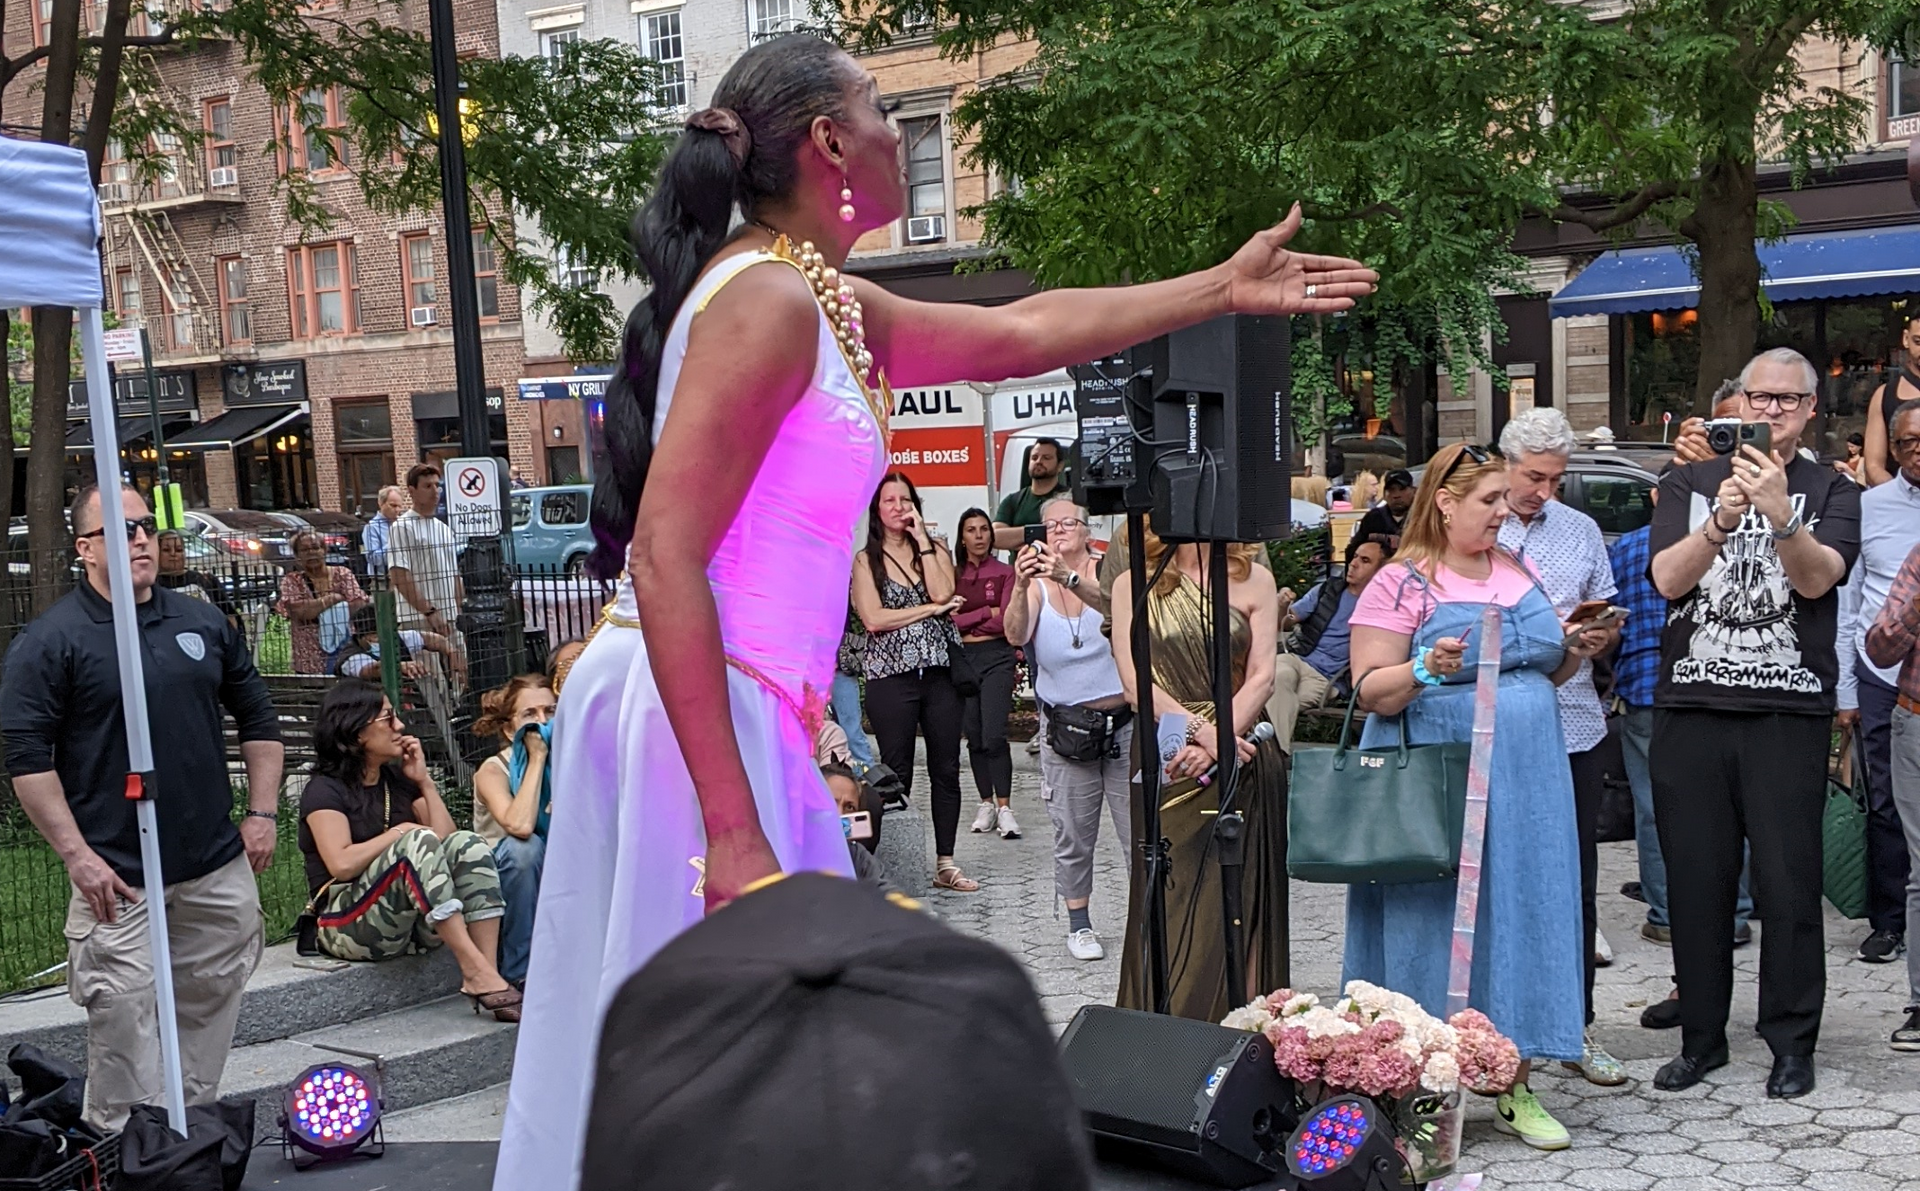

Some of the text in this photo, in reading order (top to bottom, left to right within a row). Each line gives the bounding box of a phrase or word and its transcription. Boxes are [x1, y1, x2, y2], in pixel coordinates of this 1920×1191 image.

[567, 383, 581, 397] NY
[890, 390, 962, 416] AUL
[1186, 403, 1198, 454] HEADRUSH
[887, 449, 969, 465] OBE BOXES
[455, 502, 492, 514] No Dogs
[457, 512, 493, 525] Allowed
[1205, 1066, 1228, 1098] ALTO
